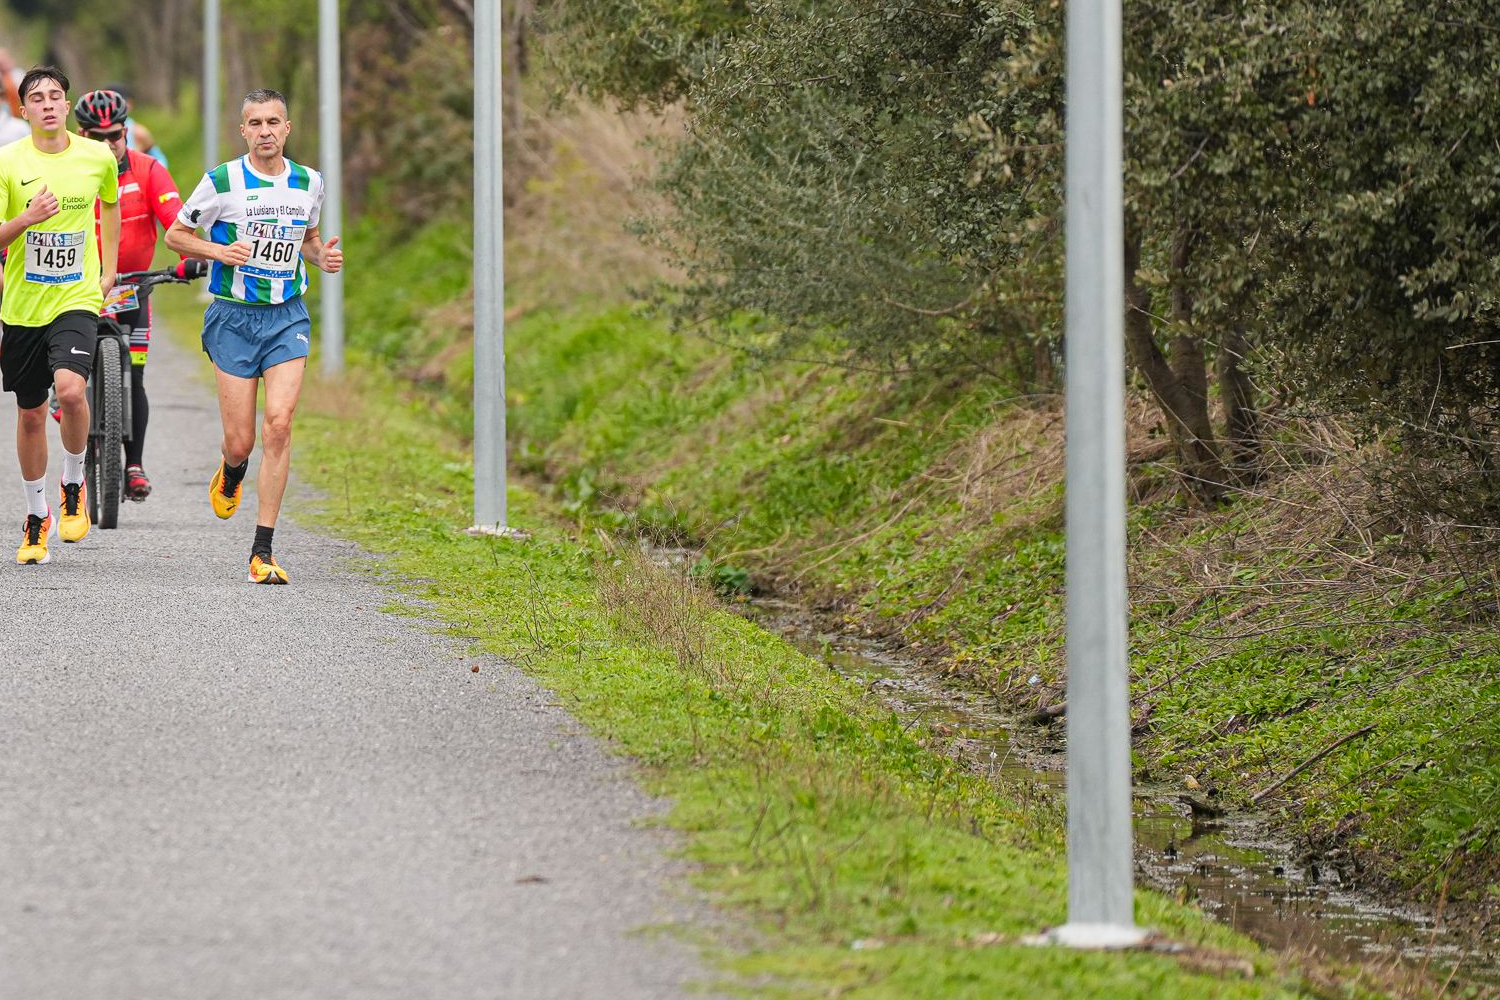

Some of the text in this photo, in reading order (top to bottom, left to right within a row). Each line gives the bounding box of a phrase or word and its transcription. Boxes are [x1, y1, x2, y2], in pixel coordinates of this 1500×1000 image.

[245, 207, 253, 216] La
[253, 204, 275, 216] Luisiana
[280, 205, 285, 215] El
[253, 222, 275, 238] 21K
[33, 232, 54, 247] 21K
[34, 247, 76, 269] 1459
[252, 239, 294, 263] 1460
